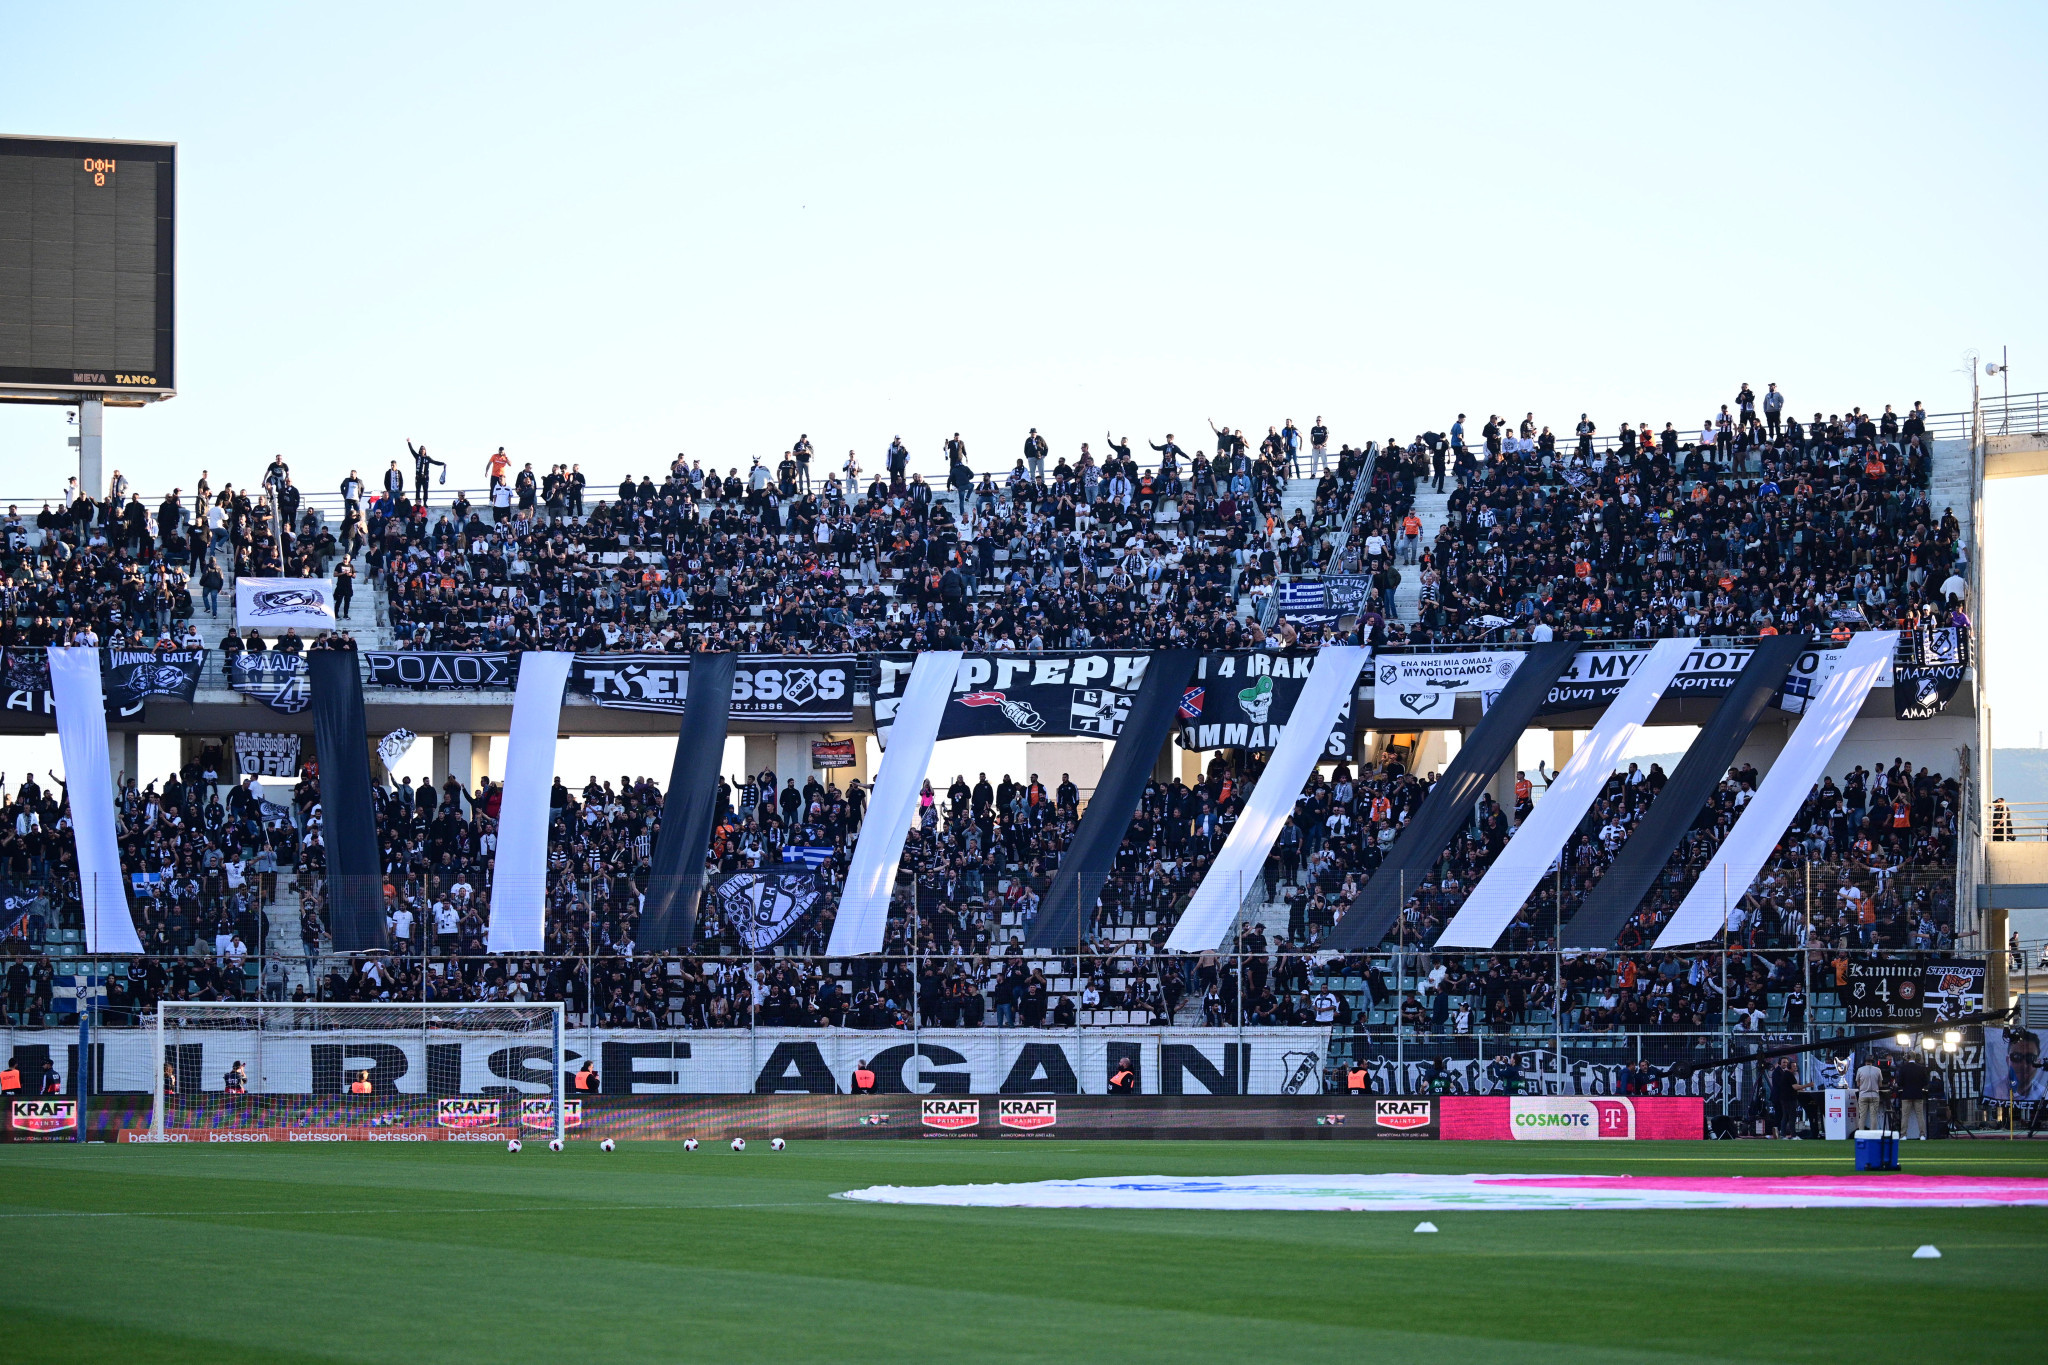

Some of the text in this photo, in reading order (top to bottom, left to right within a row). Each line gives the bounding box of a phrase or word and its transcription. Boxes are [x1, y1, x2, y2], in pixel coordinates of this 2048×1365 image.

[84, 158, 116, 173] ΟΦΗ
[94, 172, 105, 187] 0
[73, 373, 107, 384] MEVA
[110, 650, 204, 669] VIANNOS GATE 4
[1217, 656, 1236, 679] 4
[1246, 652, 1320, 679] IRAK
[1421, 659, 1441, 667] ΝΗΣΙ
[1462, 656, 1493, 665] ΟΜΑΔΑ
[367, 654, 509, 684] ΡΟΔΟΣ
[877, 655, 1151, 695] ΓΡΓΕΡΗ
[1403, 664, 1492, 677] ΜΥΛΟΠΟΤΑΜΟΣ
[1896, 665, 1963, 683] ΠΛΑΤΑΝΟΣ
[271, 676, 309, 713] 4
[243, 755, 292, 777] OFI
[1849, 963, 1922, 978] Kaminia
[1926, 966, 1986, 977] STAVRAKIA
[1874, 977, 1891, 1004] 4
[1887, 1003, 1922, 1018] Locos
[754, 1041, 1252, 1094] AGAIN
[14, 1103, 75, 1116] KRAFT
[439, 1102, 499, 1115] KRAFT
[923, 1102, 978, 1114] KRAFT
[1000, 1102, 1055, 1114] KRAFT
[1377, 1102, 1429, 1115] KRAFT
[1604, 1108, 1622, 1129] T
[209, 1131, 269, 1143] betsson
[289, 1131, 347, 1142] betsson
[368, 1131, 427, 1142] betsson
[448, 1131, 505, 1142] betsson
